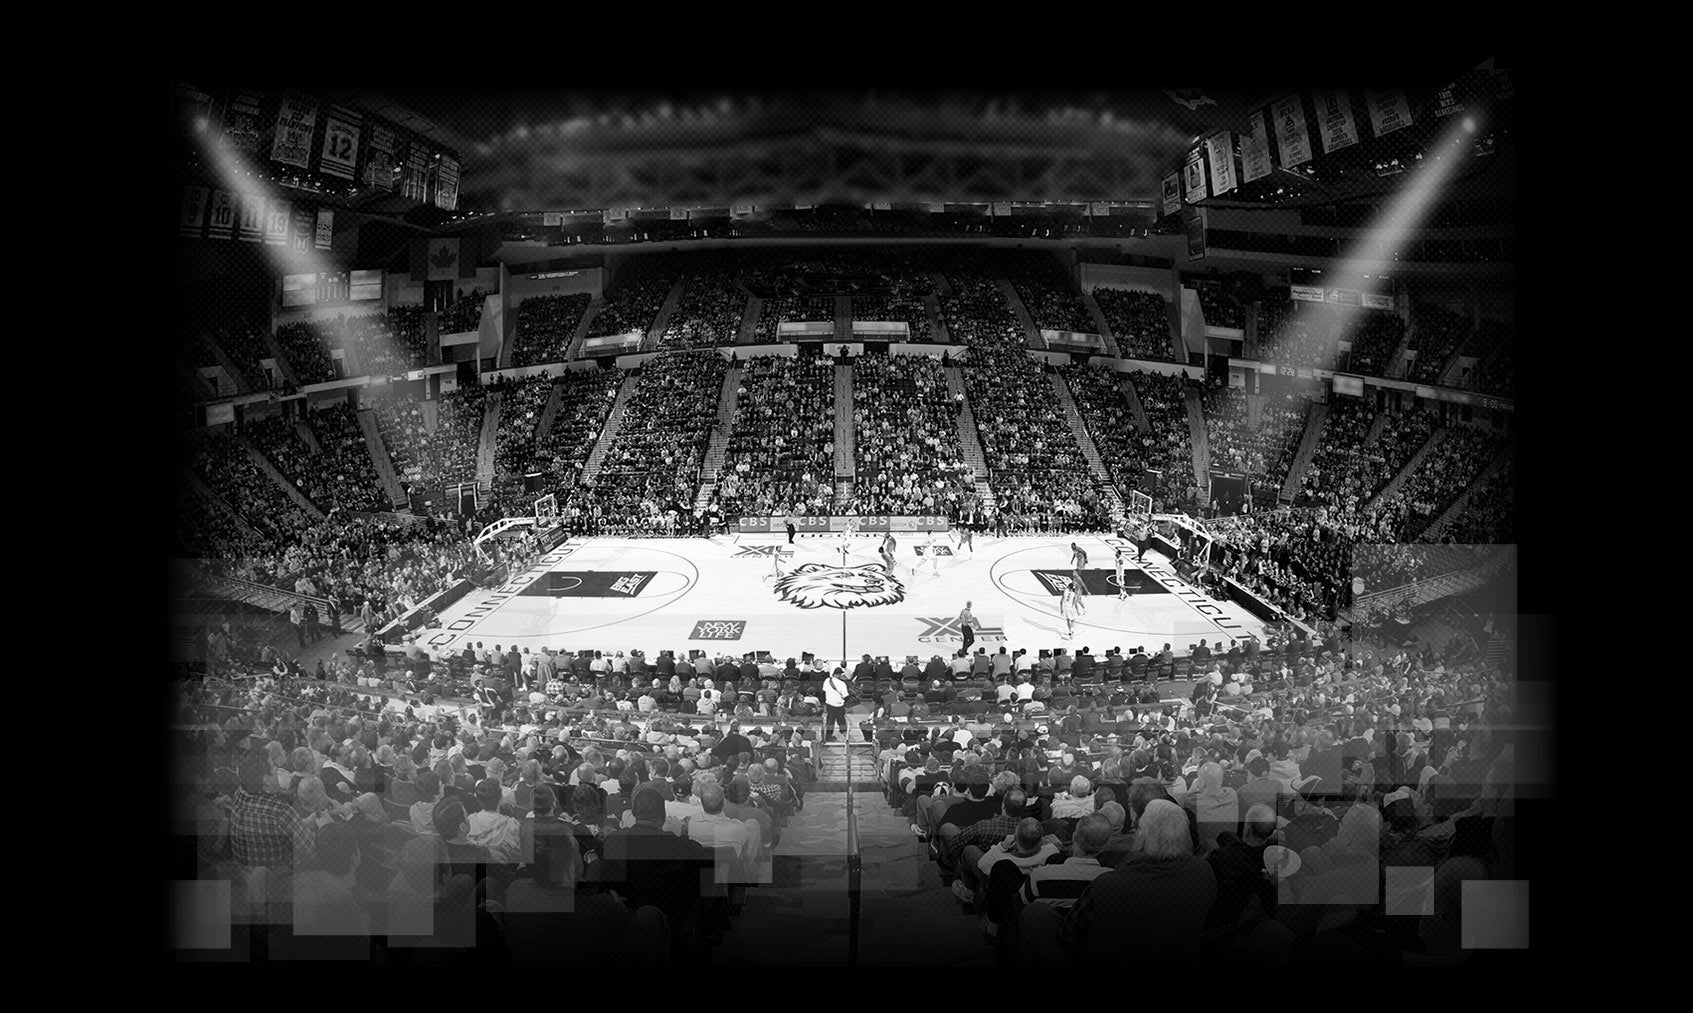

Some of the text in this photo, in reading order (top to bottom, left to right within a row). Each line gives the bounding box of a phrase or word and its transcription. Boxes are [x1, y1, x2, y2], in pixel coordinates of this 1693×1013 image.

[330, 135, 352, 160] 12
[214, 206, 231, 224] 10
[271, 212, 286, 234] 19
[740, 517, 768, 527] CBS
[799, 516, 827, 526] CBS
[859, 516, 888, 526] CBS
[917, 516, 946, 526] CBS
[610, 576, 630, 591] BIG
[620, 574, 645, 593] EAST
[1104, 539, 1261, 643] CONNECTICUT
[428, 542, 581, 645] CONNECTICUT
